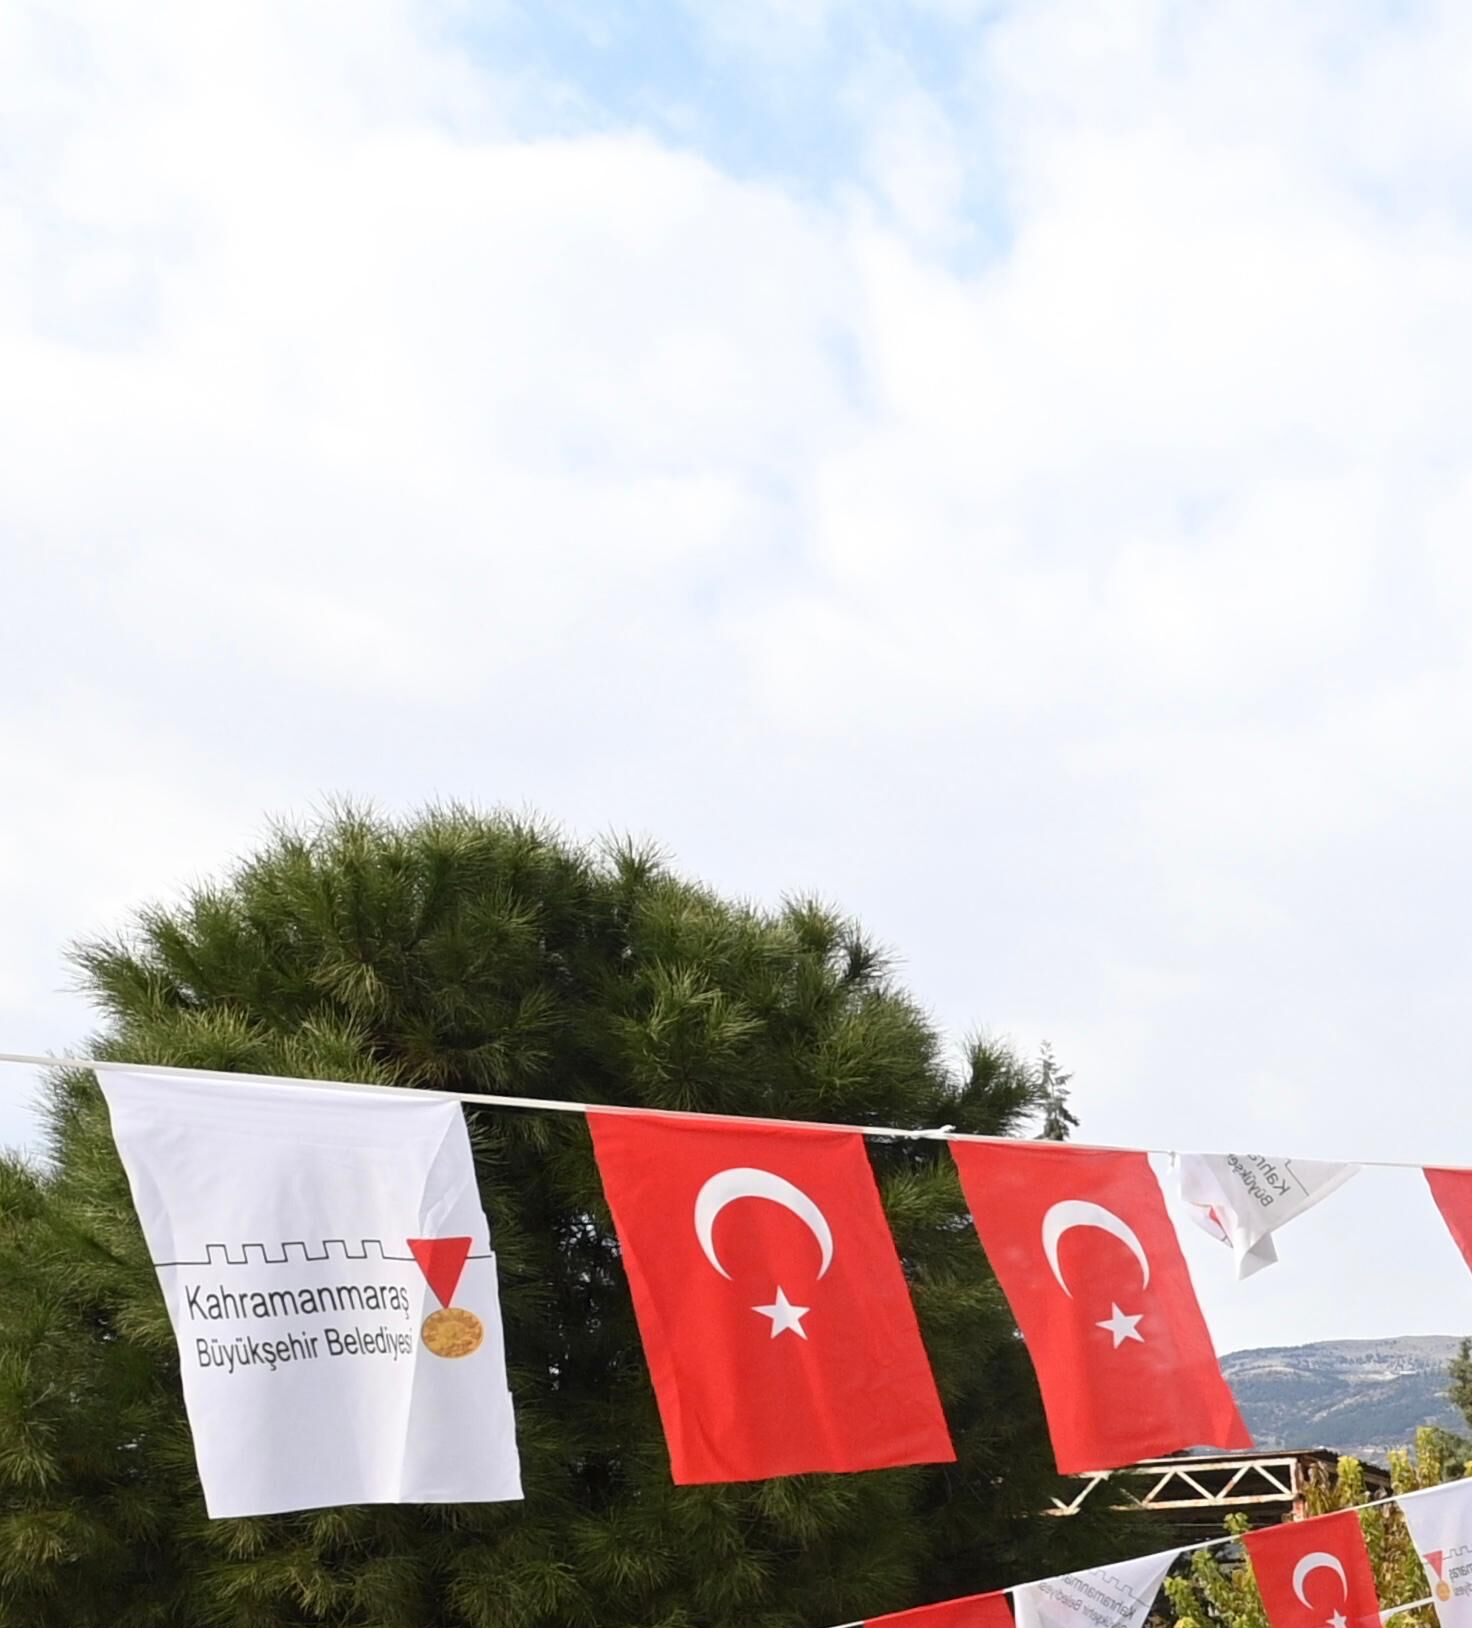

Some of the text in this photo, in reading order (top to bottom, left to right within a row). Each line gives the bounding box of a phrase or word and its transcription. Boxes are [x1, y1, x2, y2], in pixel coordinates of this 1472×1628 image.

[184, 1284, 410, 1320] Kahramanmaraş
[196, 1326, 413, 1373] Büyükşehir Belediyesi
